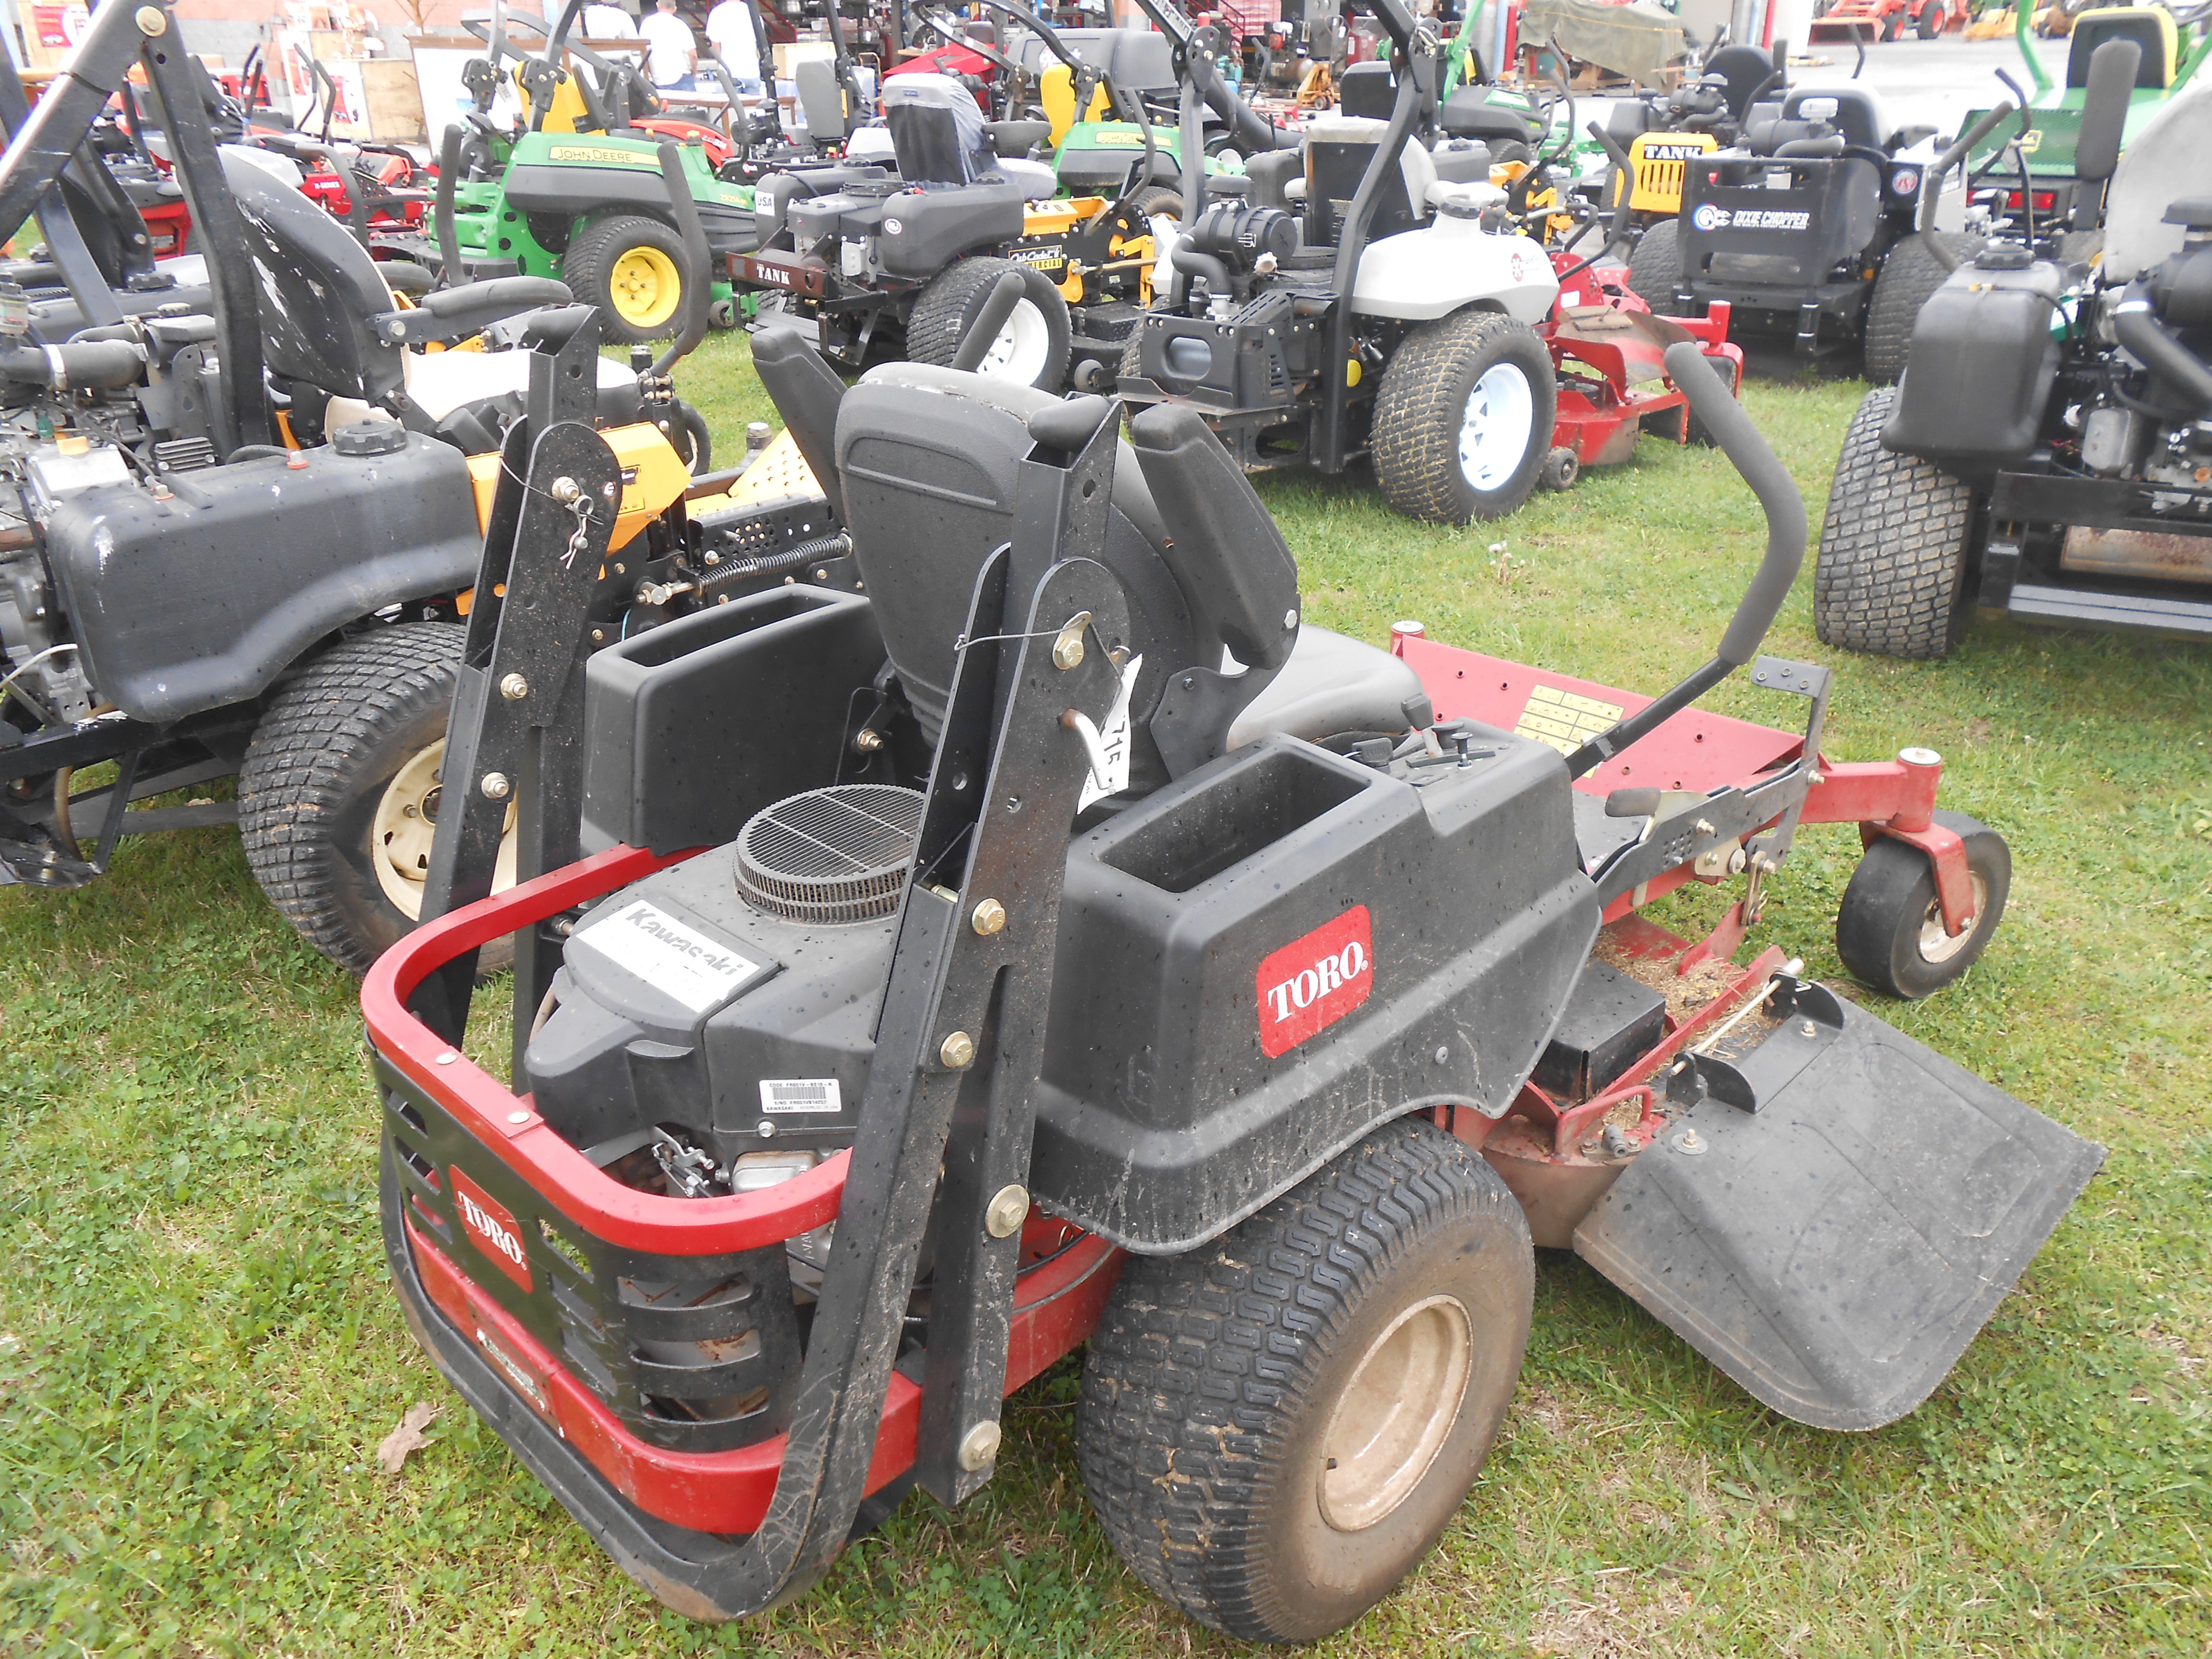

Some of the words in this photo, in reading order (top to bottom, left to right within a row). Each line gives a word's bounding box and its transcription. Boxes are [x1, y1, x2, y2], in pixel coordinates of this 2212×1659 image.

[558, 149, 590, 159] JOHN
[592, 150, 632, 161] DEERE
[1645, 145, 1701, 159] TANK
[757, 196, 772, 207] USA
[1733, 210, 1763, 224] DIXIE
[1761, 211, 1810, 226] CHOPPER
[1010, 252, 1027, 262] Cub
[1027, 250, 1054, 261] Cadet
[1028, 259, 1060, 269] ERCIAL
[757, 263, 790, 285] TANK
[1104, 714, 1125, 765] 715
[625, 908, 744, 976] Kawasaki
[1267, 941, 1364, 1023] TORO
[458, 1190, 522, 1264] TORO
